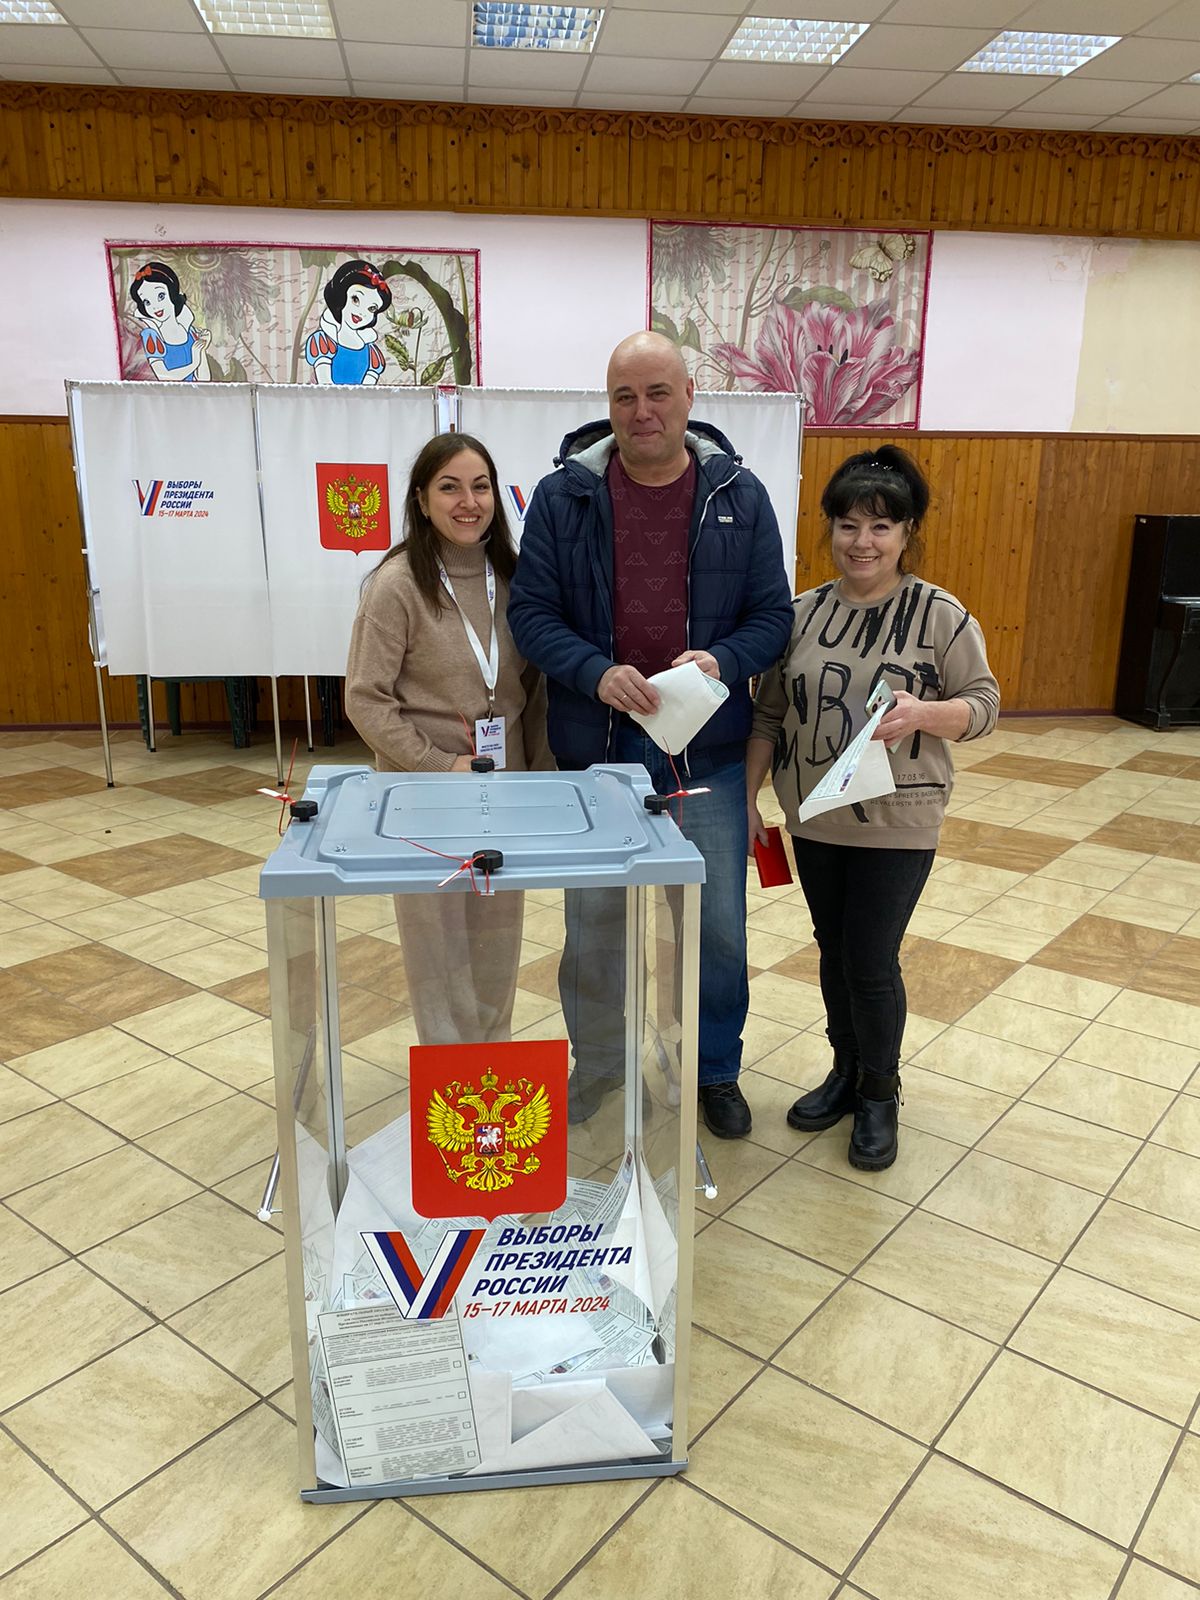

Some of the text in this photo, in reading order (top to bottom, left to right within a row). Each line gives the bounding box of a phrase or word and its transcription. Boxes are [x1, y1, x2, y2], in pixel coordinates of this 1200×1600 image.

[163, 490, 214, 500] ПРЕЗИДЕНТА
[166, 480, 203, 489] ВЫБОРЫ
[160, 500, 193, 509] РОССИИ
[497, 1224, 604, 1247] ВЫБОРЫ
[484, 1246, 633, 1272] ПРЕЗИДЕНТА
[472, 1275, 570, 1297] РОССИИ
[510, 1299, 568, 1317] МАРТА
[569, 1296, 611, 1313] 2024
